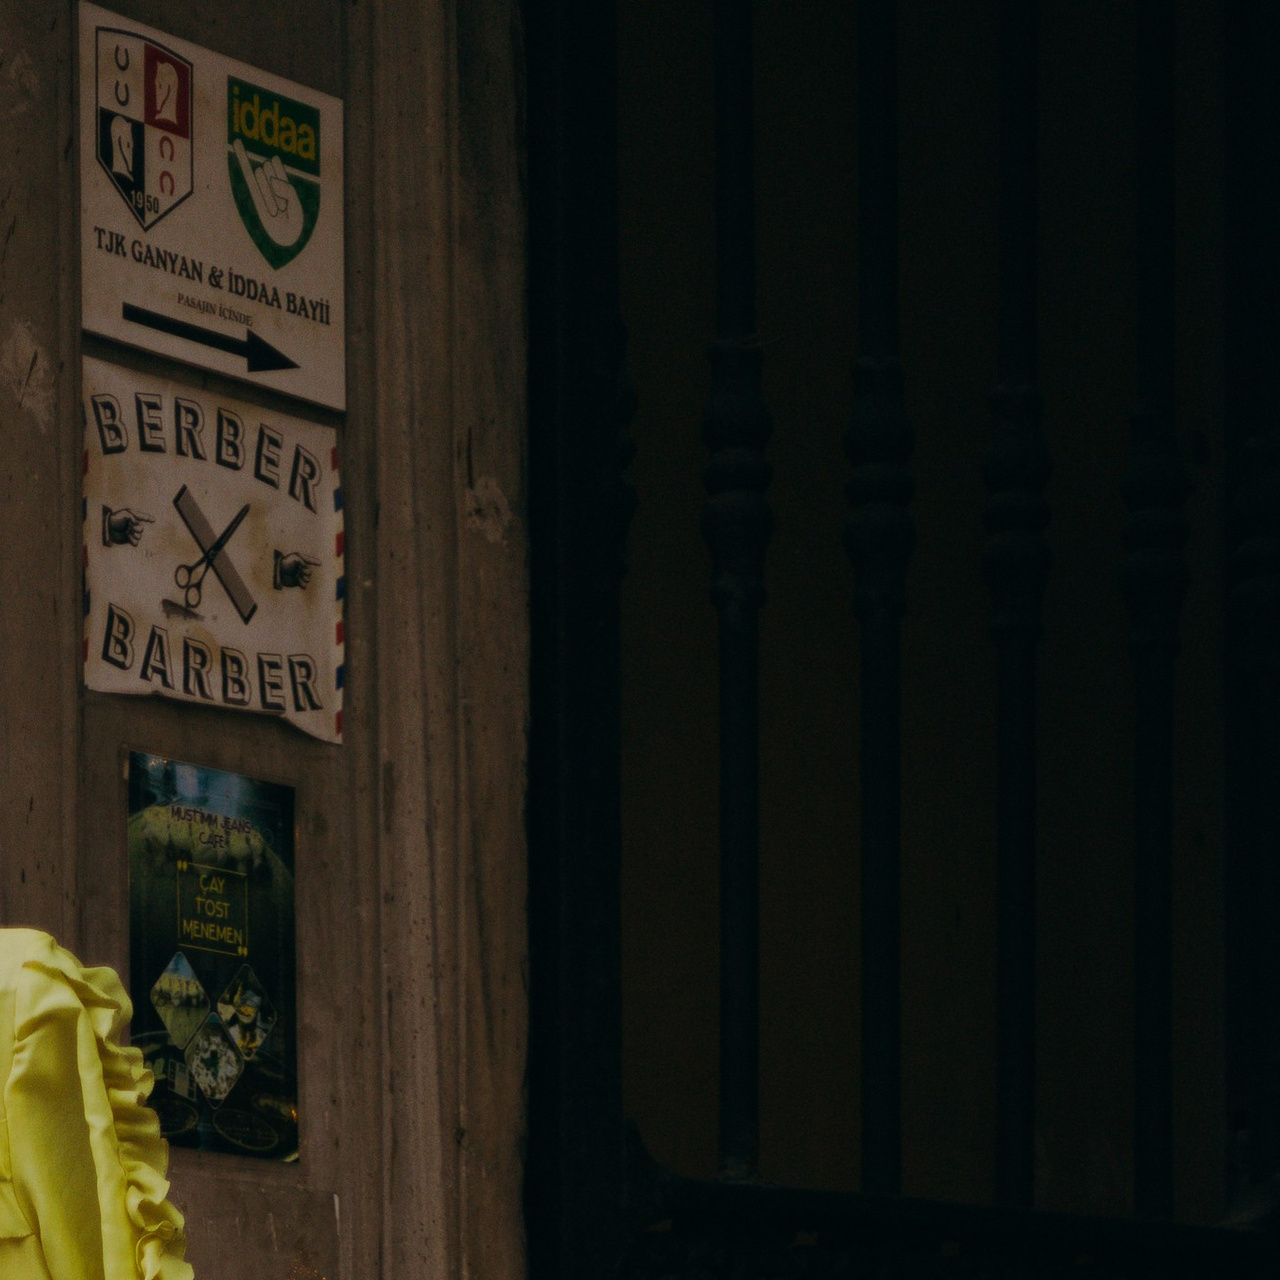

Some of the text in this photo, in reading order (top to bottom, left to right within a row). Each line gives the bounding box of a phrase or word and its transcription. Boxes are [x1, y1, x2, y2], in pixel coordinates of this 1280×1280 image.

[232, 85, 317, 161] iddaa
[94, 226, 127, 258] TJK
[132, 240, 203, 284] GANYAN
[208, 266, 224, 290] &
[228, 266, 282, 310] İDDAA
[91, 392, 321, 515] BERBER
[101, 602, 324, 713] BARBER
[195, 895, 231, 920] TOST
[198, 874, 226, 898] ÇAY
[182, 918, 243, 946] MENEMEN
